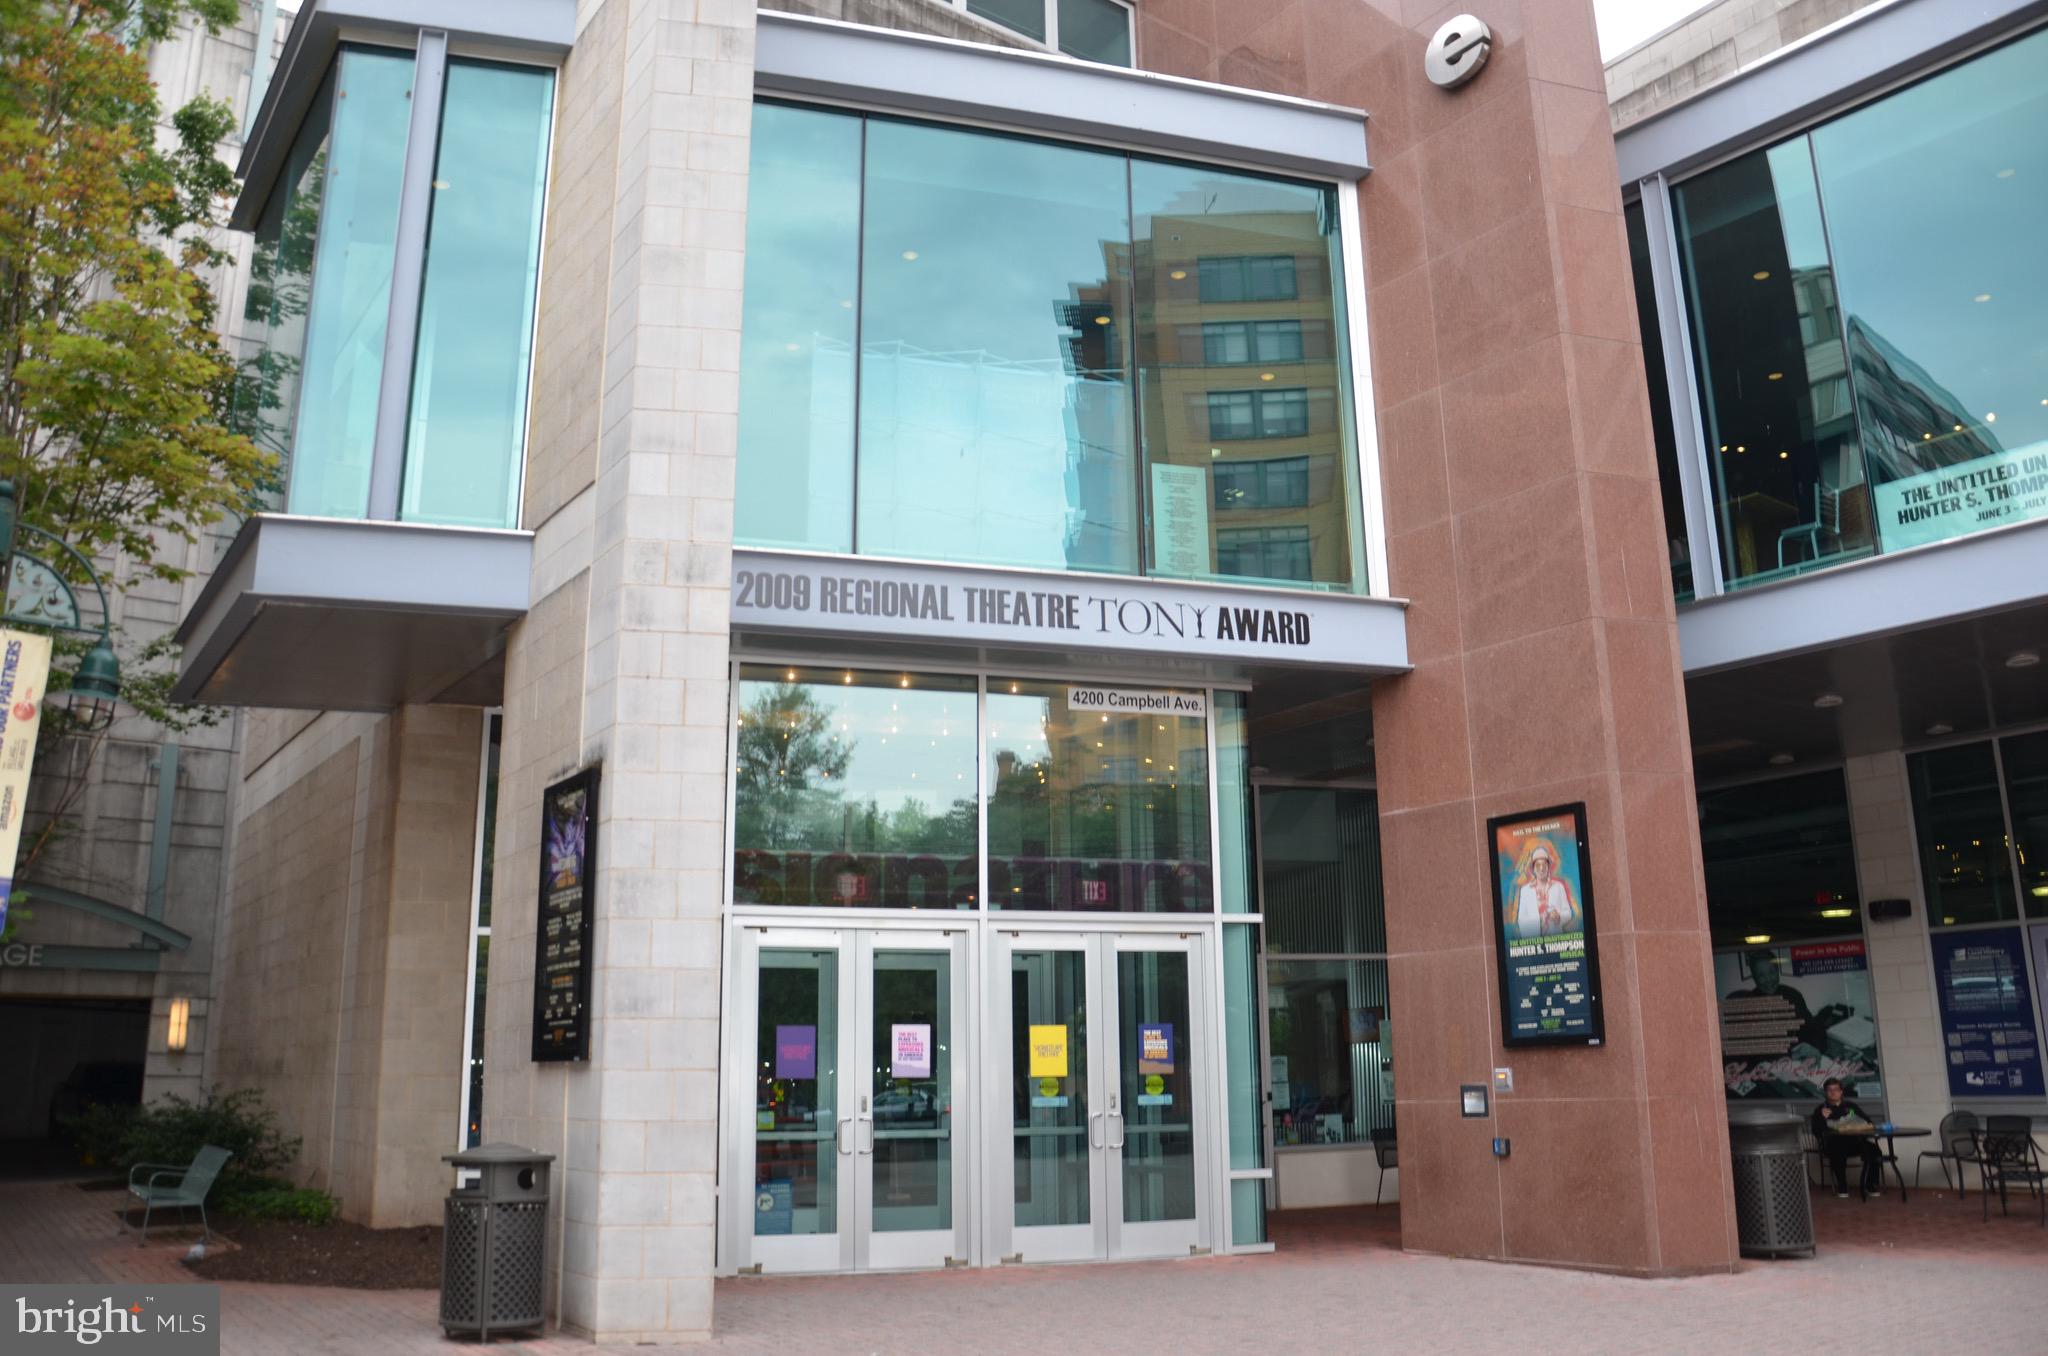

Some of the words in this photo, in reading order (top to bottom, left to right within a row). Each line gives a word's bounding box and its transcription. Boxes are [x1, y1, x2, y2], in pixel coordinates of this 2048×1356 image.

[1897, 496, 1962, 525] HUNTER
[1965, 492, 1982, 508] S.
[1985, 474, 2048, 503] THOMP
[1901, 485, 1933, 505] THE
[1936, 463, 2019, 497] UNTITLED
[1976, 506, 2002, 522] JUNE
[2022, 496, 2047, 510] JULY
[736, 571, 811, 612] 2009
[819, 575, 955, 622] REGIONAL
[962, 587, 1080, 630] THEATRE
[1087, 596, 1211, 640] TONY
[1217, 606, 1312, 646] AWARD
[0, 640, 22, 703] PARTNERS
[1072, 690, 1104, 705] 4200
[1108, 692, 1170, 711] Campbell
[1174, 697, 1202, 711] Ave.
[0, 944, 43, 966] GE
[1510, 944, 1536, 957] HUNTER
[1545, 939, 1584, 954] THOMPSON
